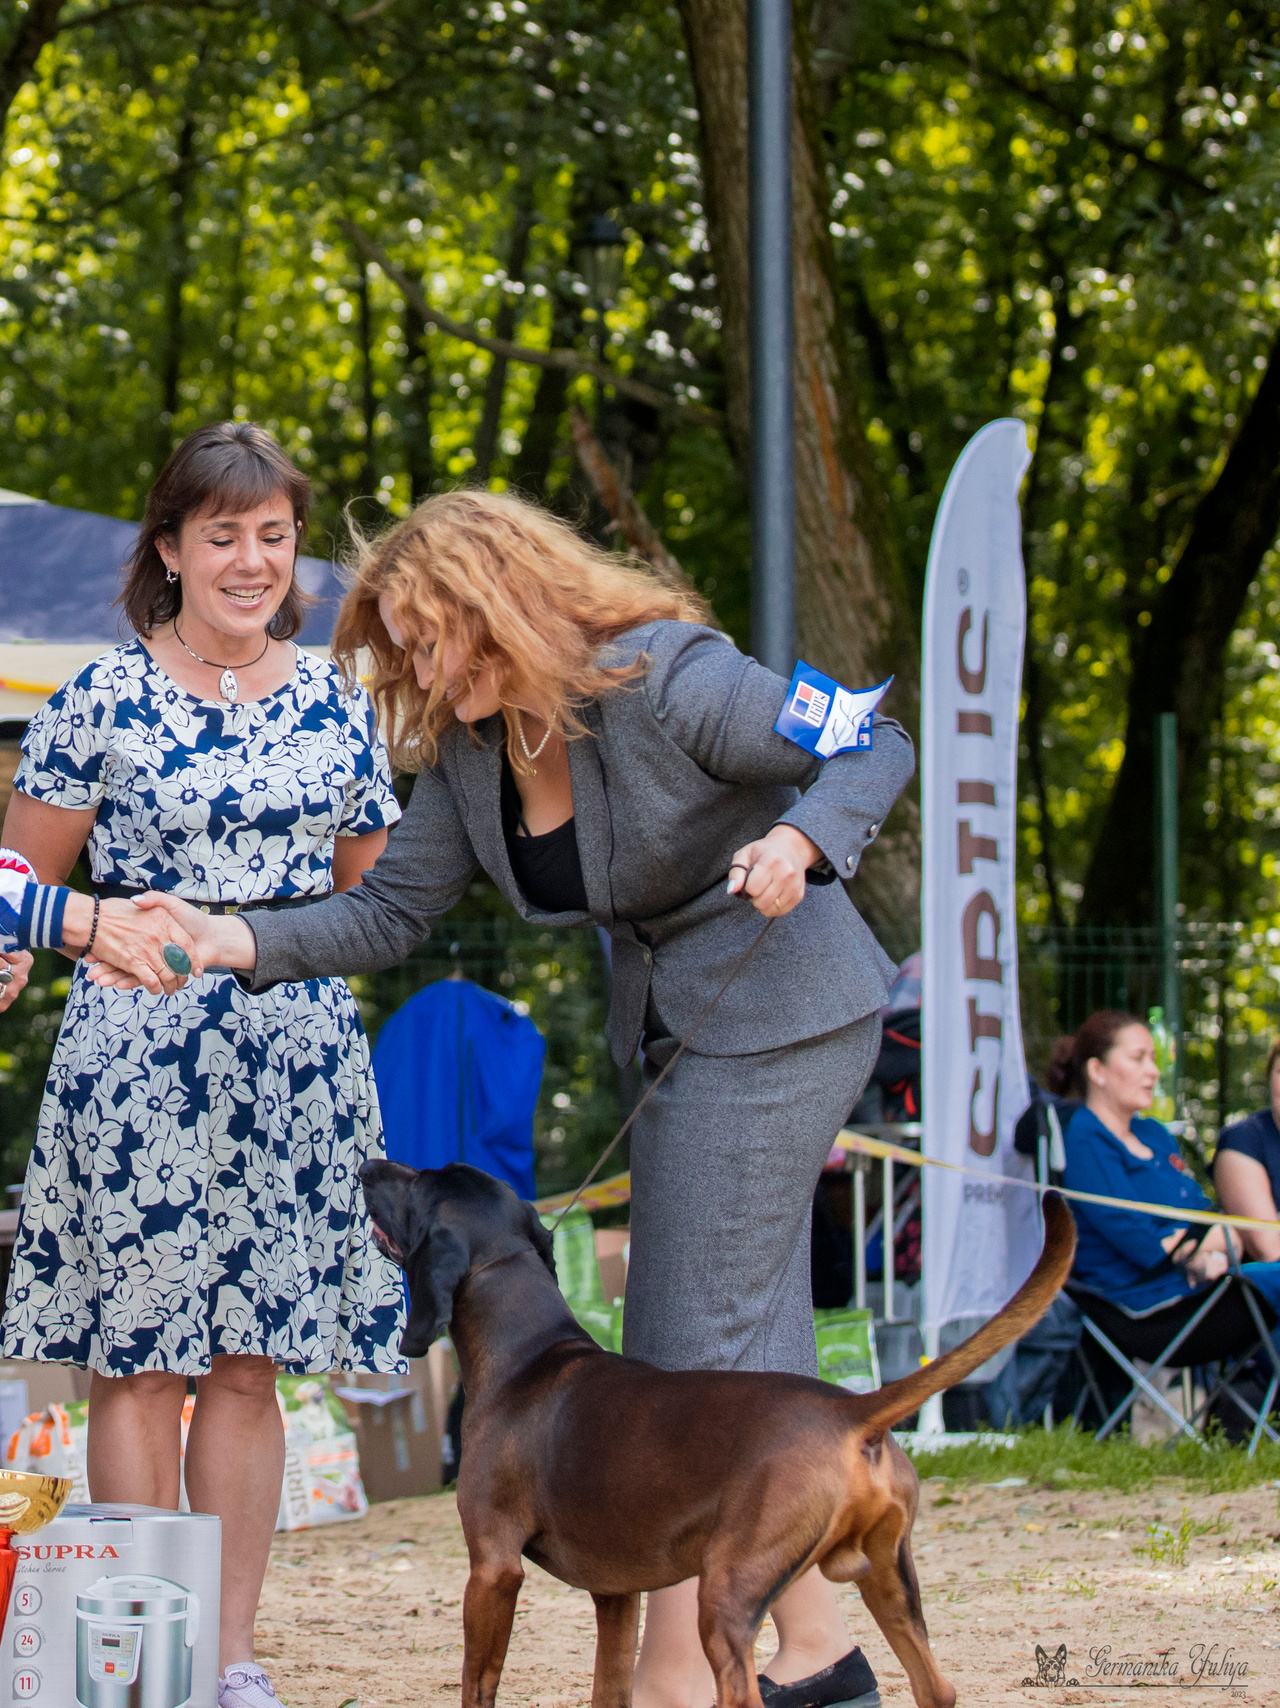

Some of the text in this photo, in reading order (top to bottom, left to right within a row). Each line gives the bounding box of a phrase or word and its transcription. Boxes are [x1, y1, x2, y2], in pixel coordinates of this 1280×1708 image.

[15, 1544, 120, 1560] SUPRA
[21, 1593, 29, 1607] 5
[20, 1634, 34, 1646] 24
[19, 1676, 31, 1690] 11
